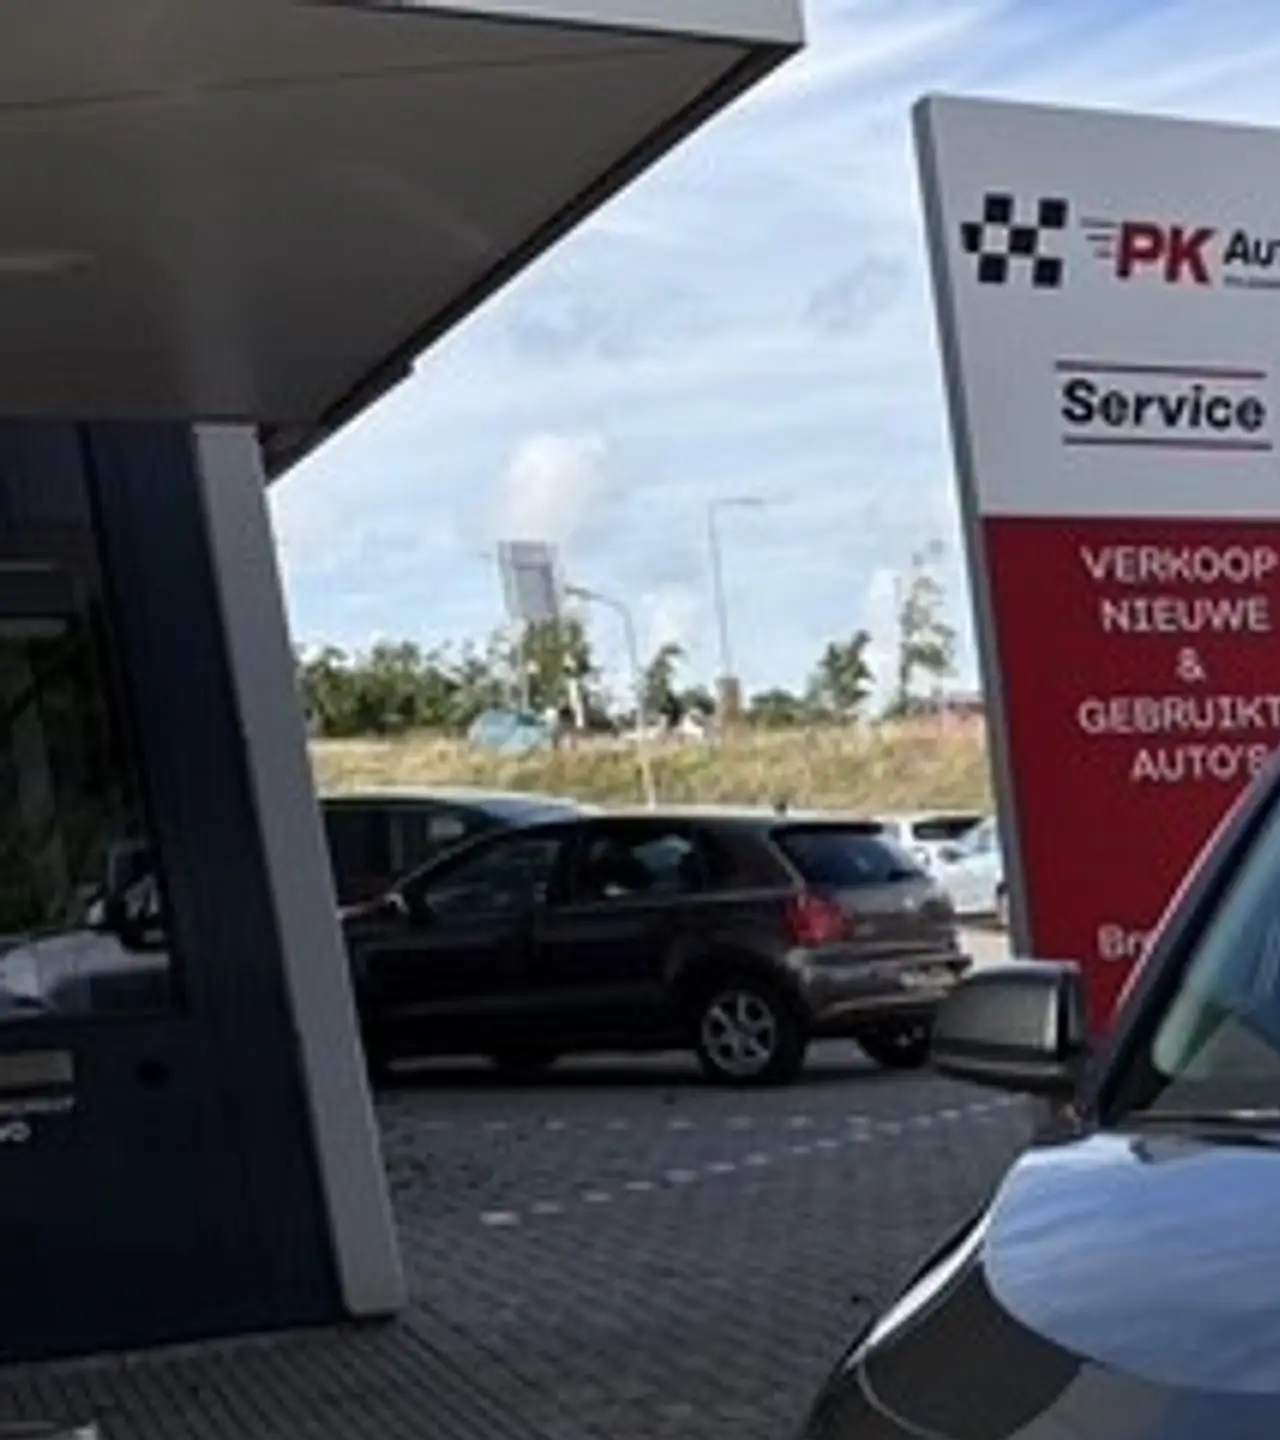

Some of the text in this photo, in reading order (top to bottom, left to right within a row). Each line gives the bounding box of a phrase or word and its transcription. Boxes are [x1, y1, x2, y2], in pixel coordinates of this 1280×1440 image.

[1116, 221, 1216, 285] PK
[1061, 378, 1267, 433] Service
[1081, 545, 1279, 582] VERKOOP
[1101, 597, 1271, 633] NIEUWE
[1175, 647, 1206, 680] &
